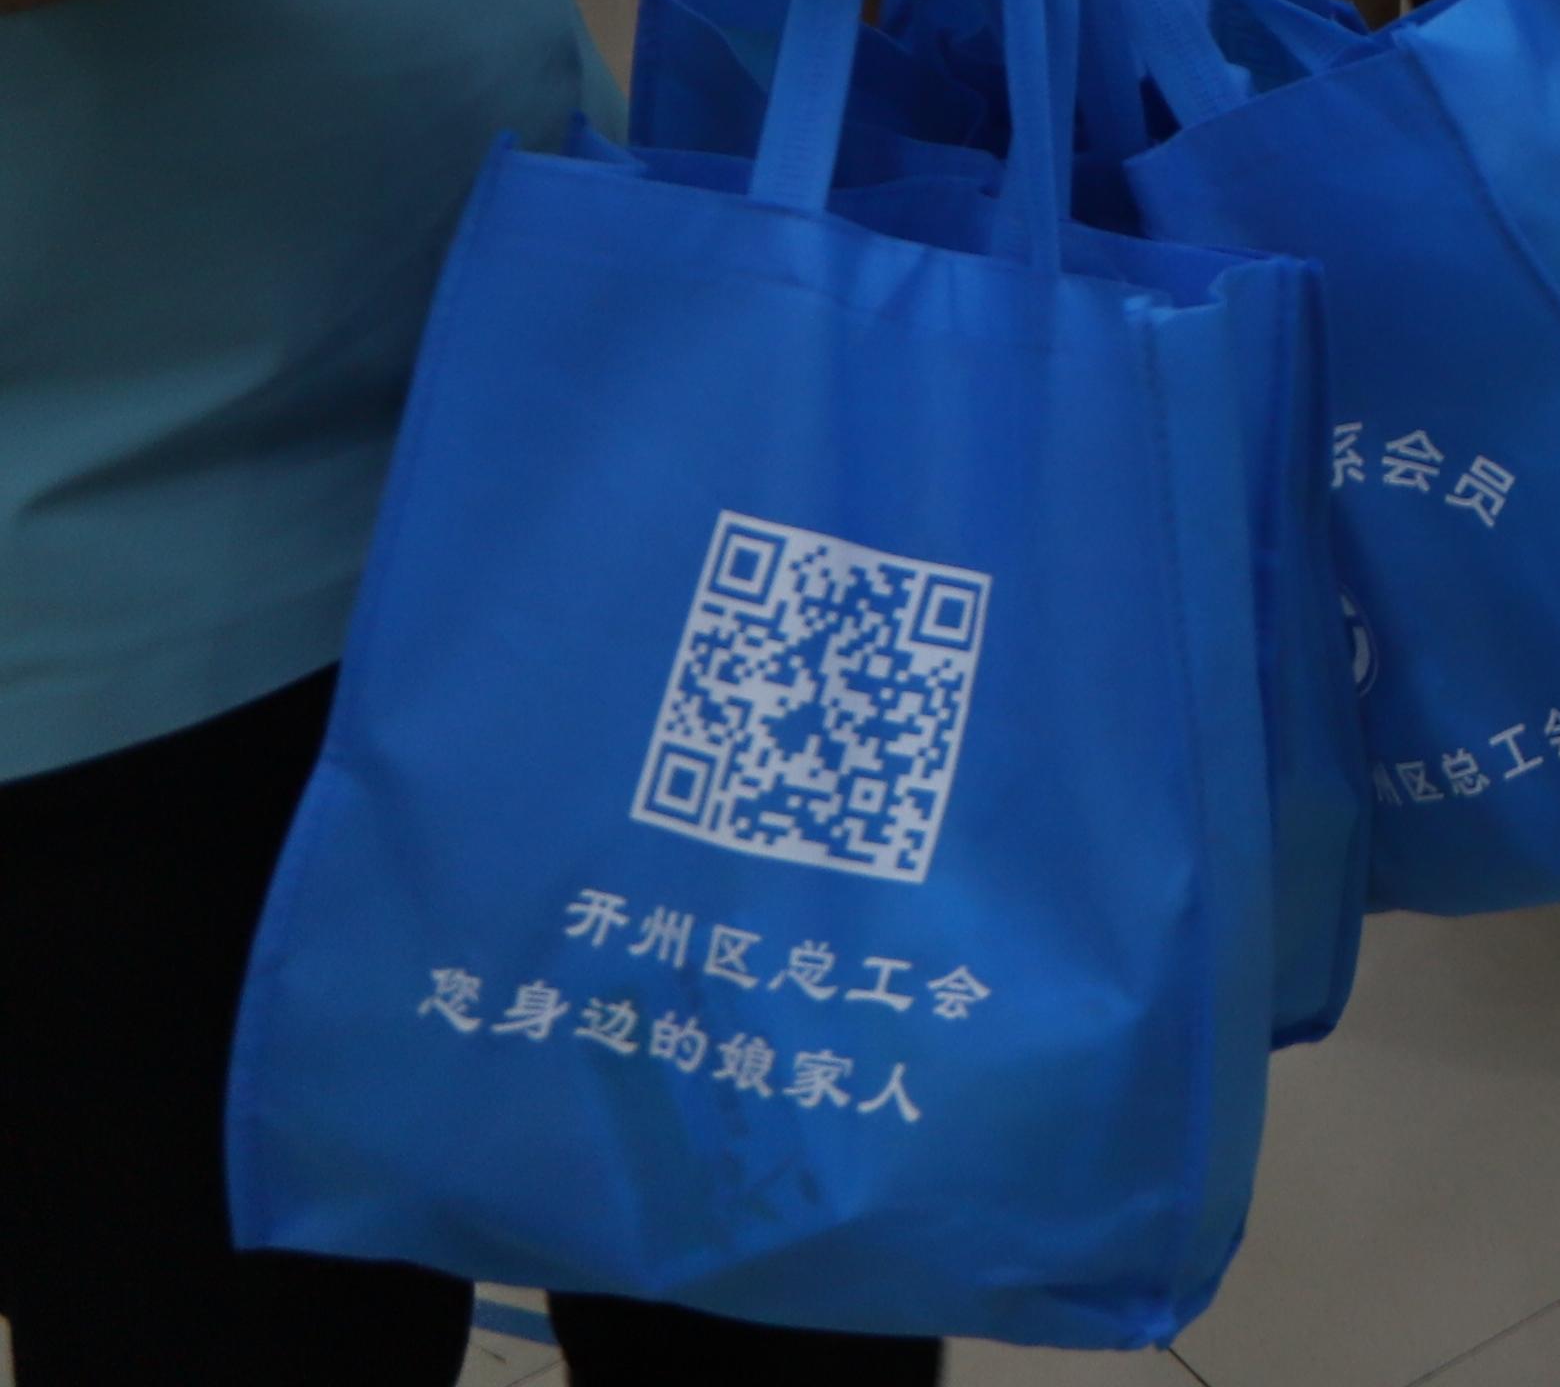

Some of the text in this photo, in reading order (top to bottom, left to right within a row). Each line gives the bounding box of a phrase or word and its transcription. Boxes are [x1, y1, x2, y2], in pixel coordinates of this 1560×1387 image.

[566, 888, 993, 1023] 开州区总工会
[416, 964, 922, 1125] 您身边的娘家人
